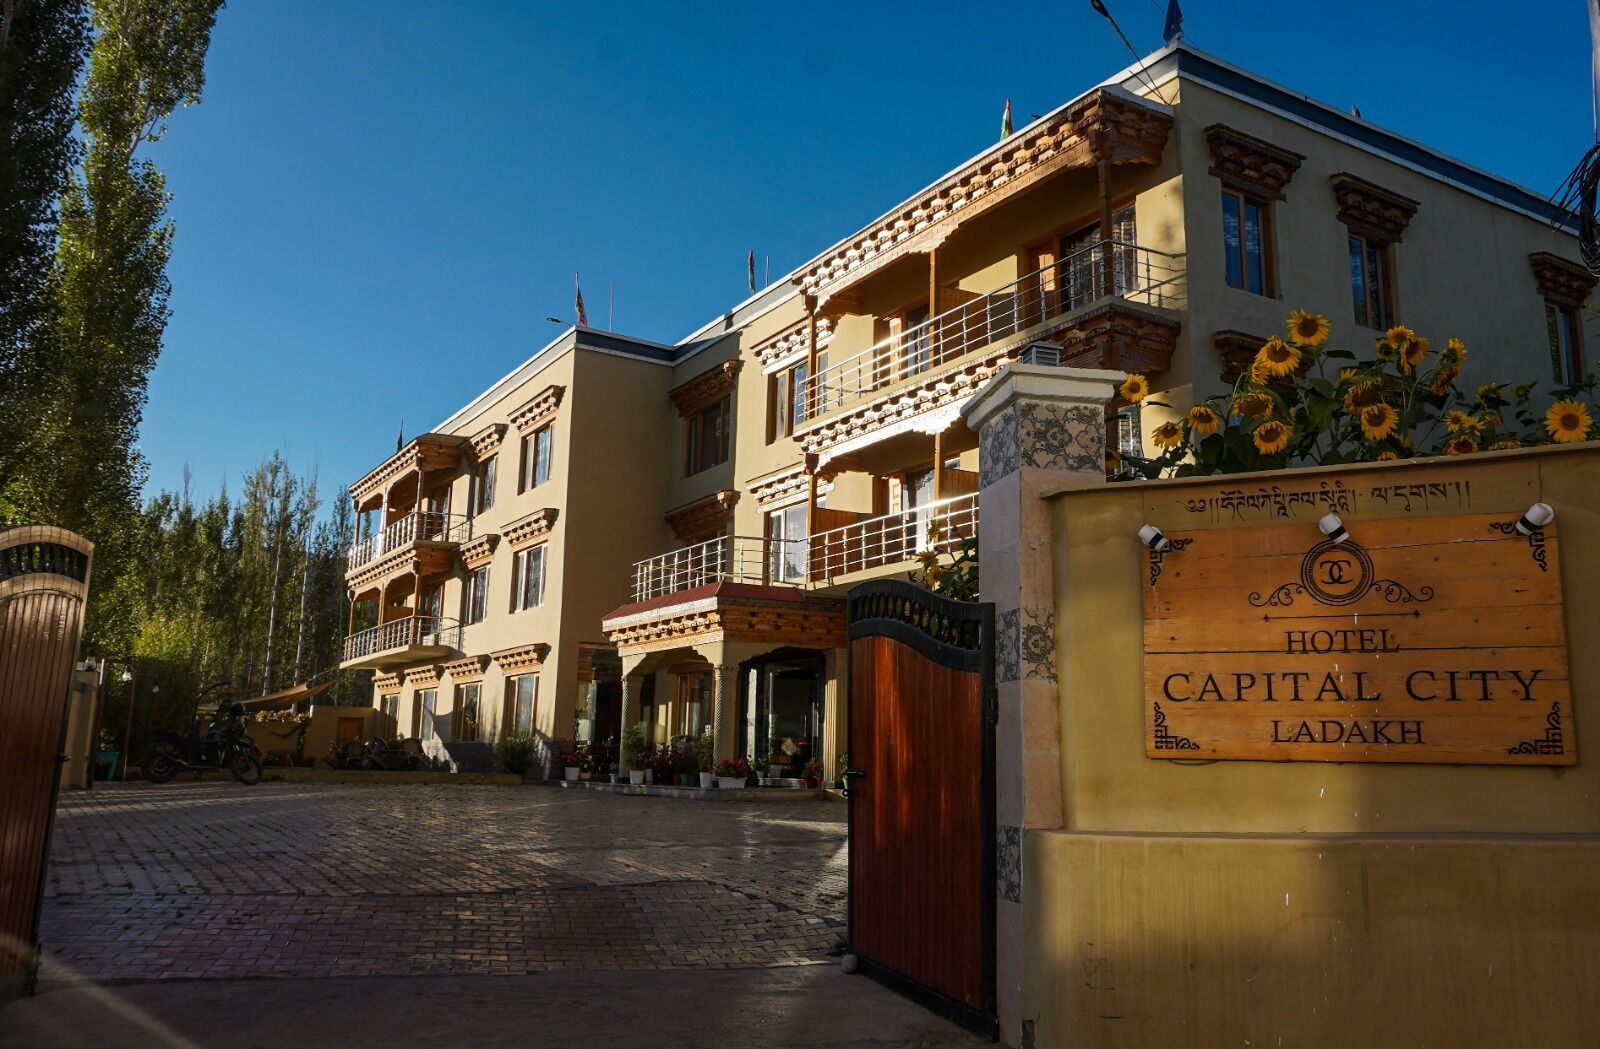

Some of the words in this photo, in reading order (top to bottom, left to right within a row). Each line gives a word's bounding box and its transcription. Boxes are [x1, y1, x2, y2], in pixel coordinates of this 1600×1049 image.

[1284, 629, 1400, 654] HOTEL
[1163, 672, 1381, 702] CAPITAL
[1405, 669, 1544, 701] CITY
[1271, 720, 1426, 745] LADAKH
